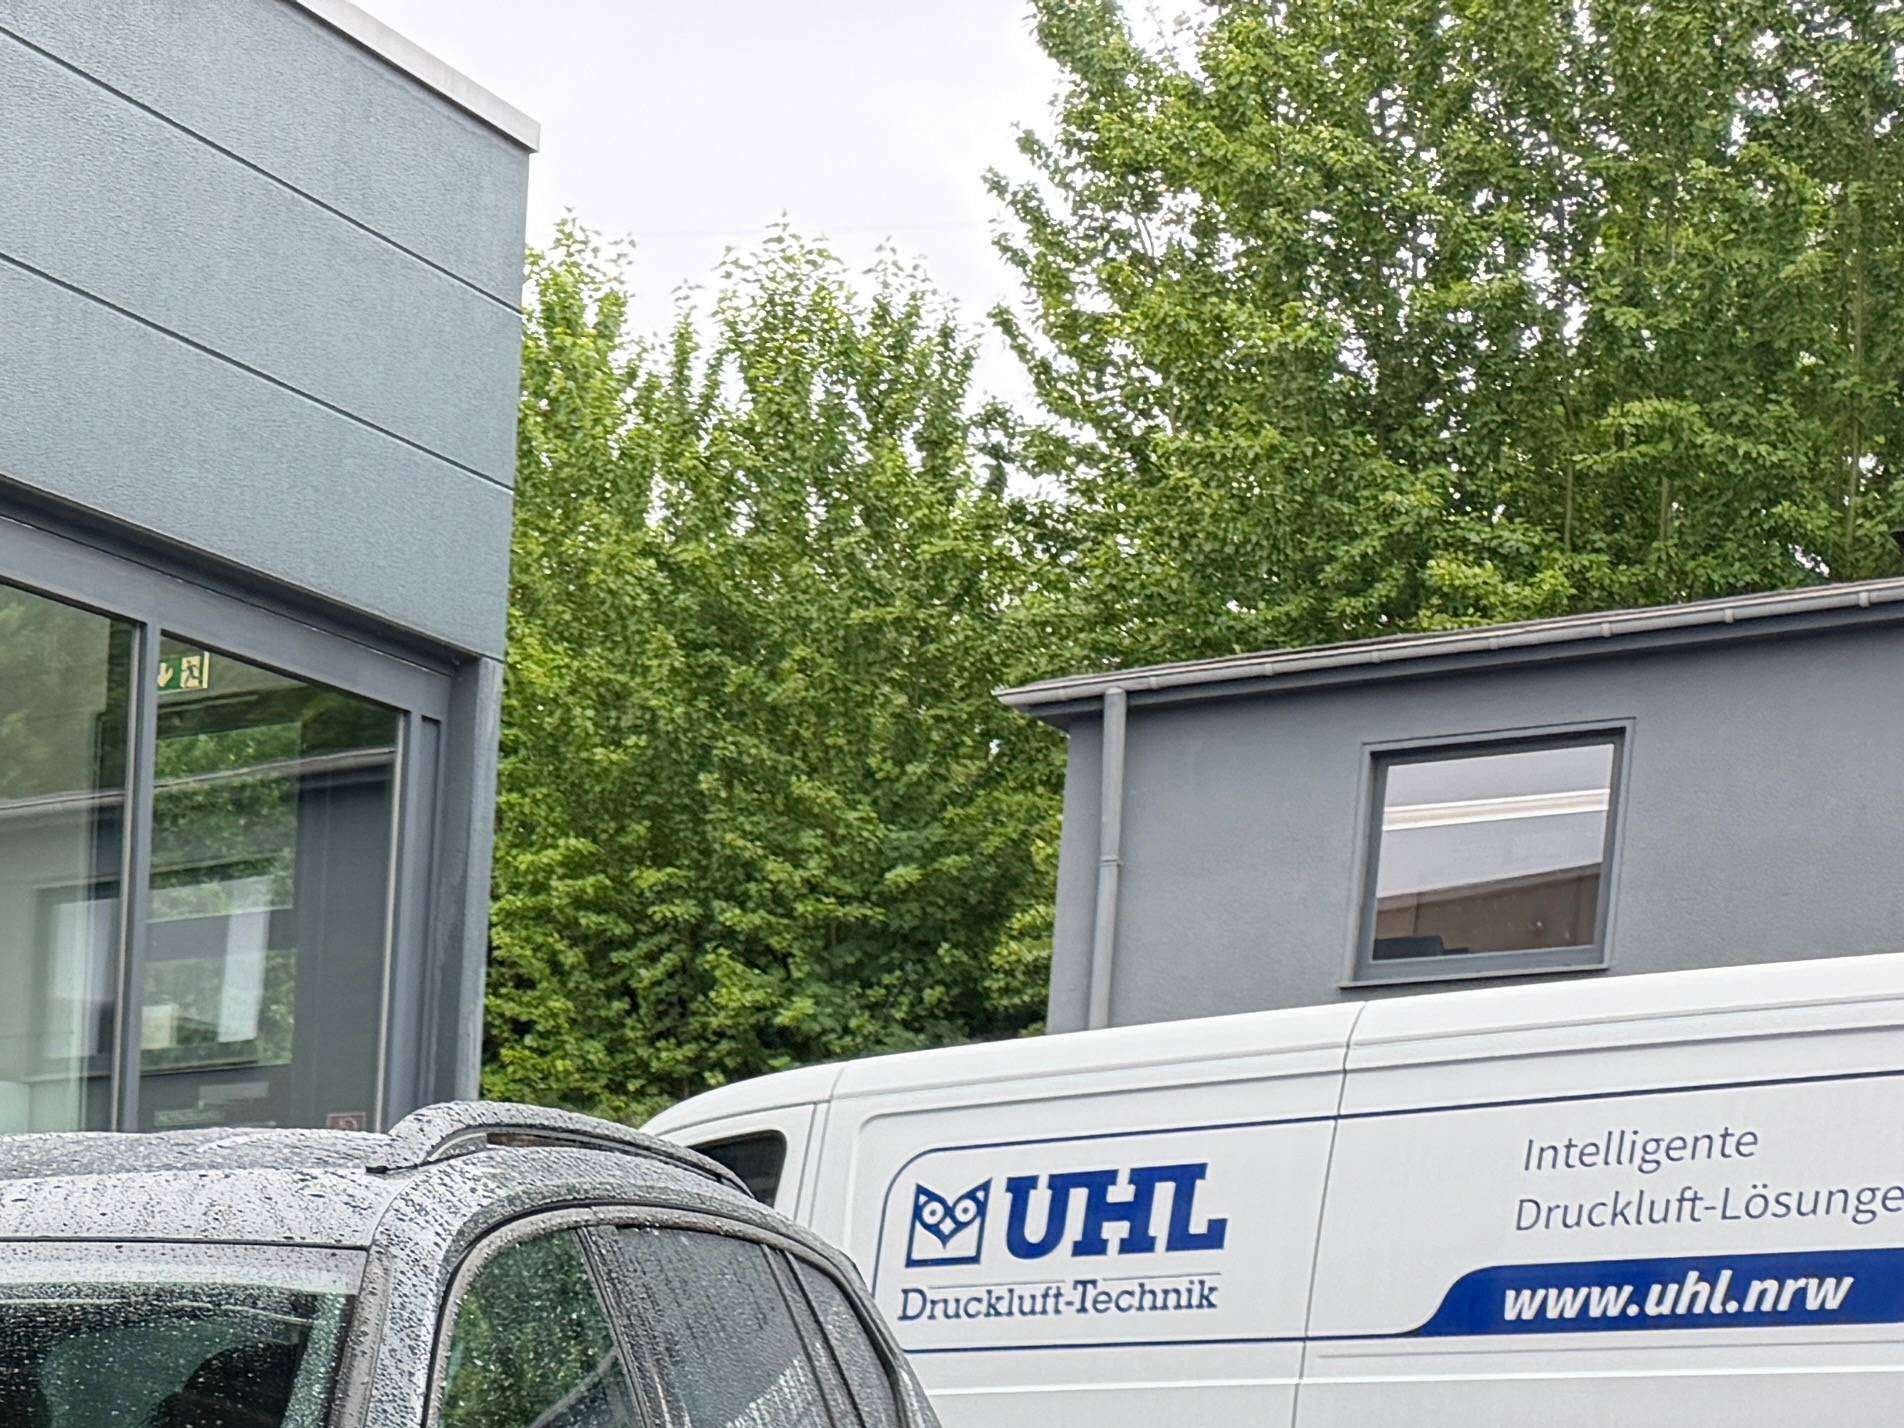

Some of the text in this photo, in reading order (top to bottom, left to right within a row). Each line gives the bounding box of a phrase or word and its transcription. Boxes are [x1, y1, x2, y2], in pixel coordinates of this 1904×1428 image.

[1522, 1125, 1760, 1175] Intelligente
[1004, 1161, 1229, 1260] UHL
[896, 1278, 1220, 1322] Druckluft-Technik
[1502, 1268, 1856, 1322] www.uhl.nrw
